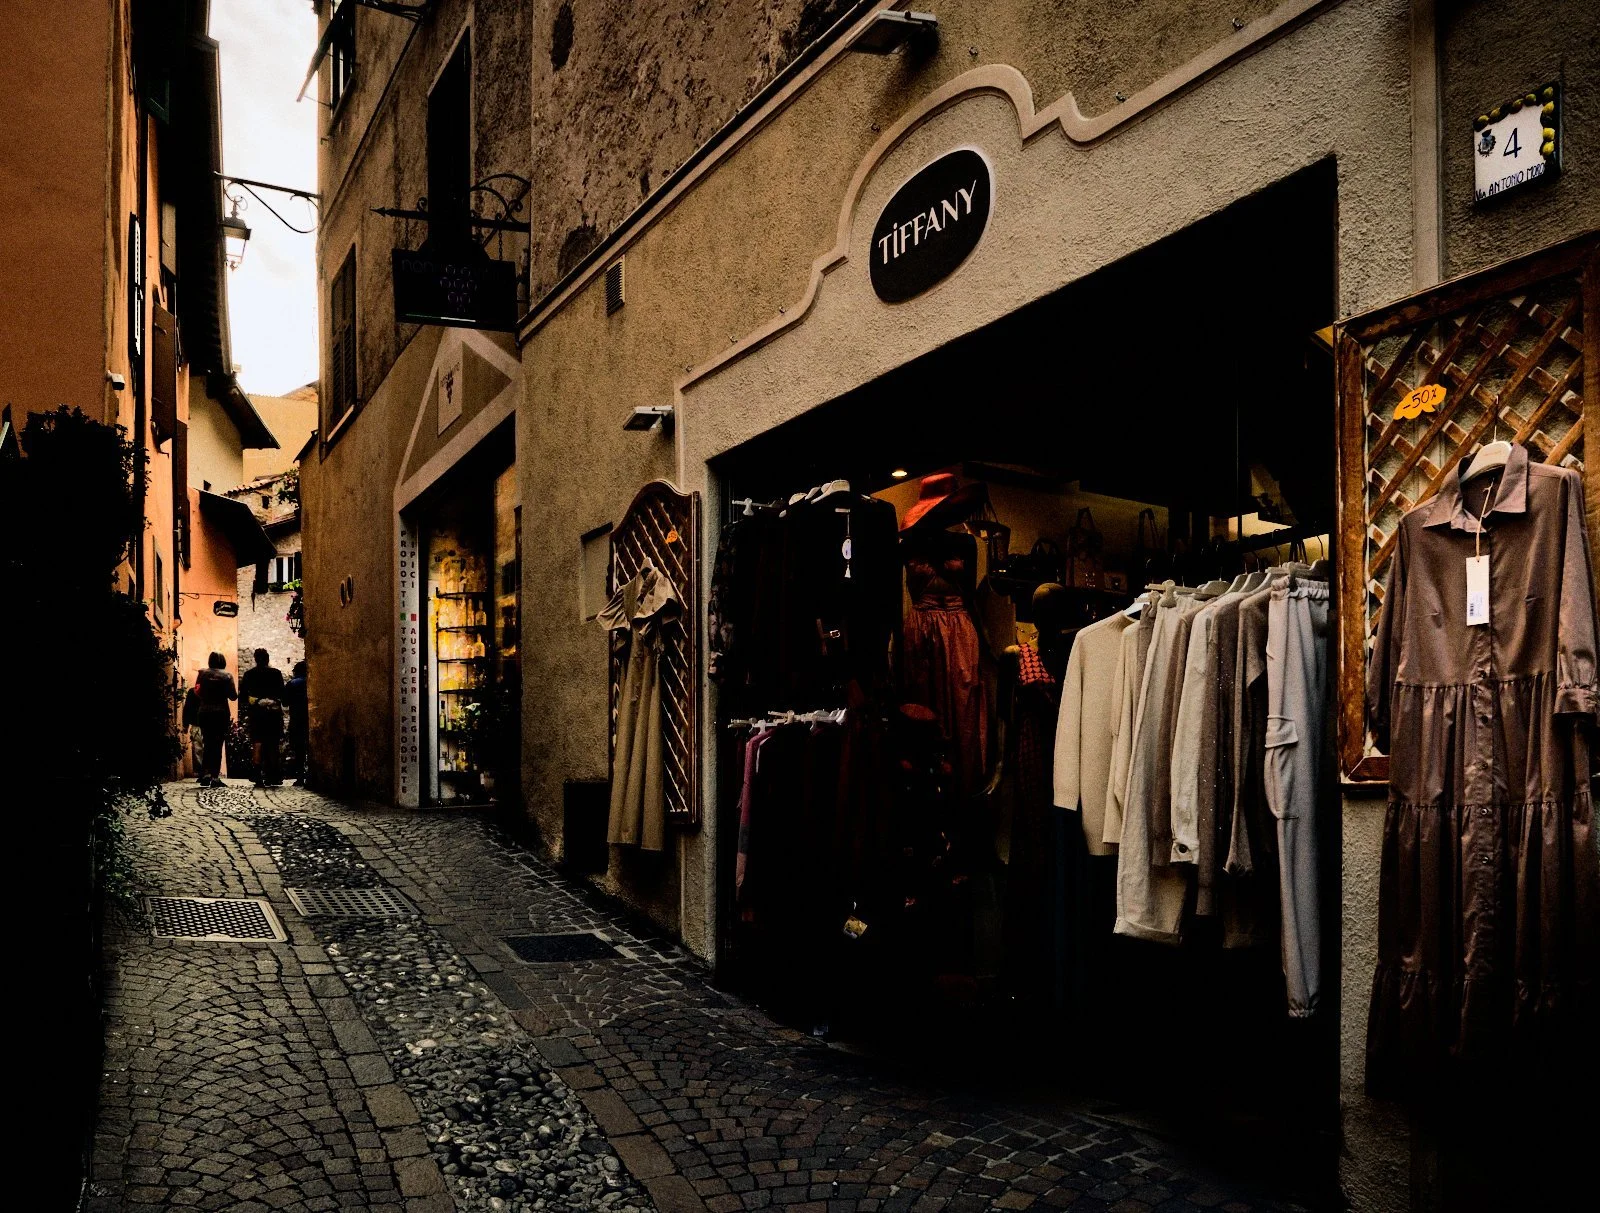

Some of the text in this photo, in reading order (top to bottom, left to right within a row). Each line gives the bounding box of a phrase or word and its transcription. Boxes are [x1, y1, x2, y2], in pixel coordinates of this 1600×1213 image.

[1503, 127, 1522, 159] 4
[1489, 171, 1524, 196] ANTONIO
[1403, 388, 1437, 410] -50%
